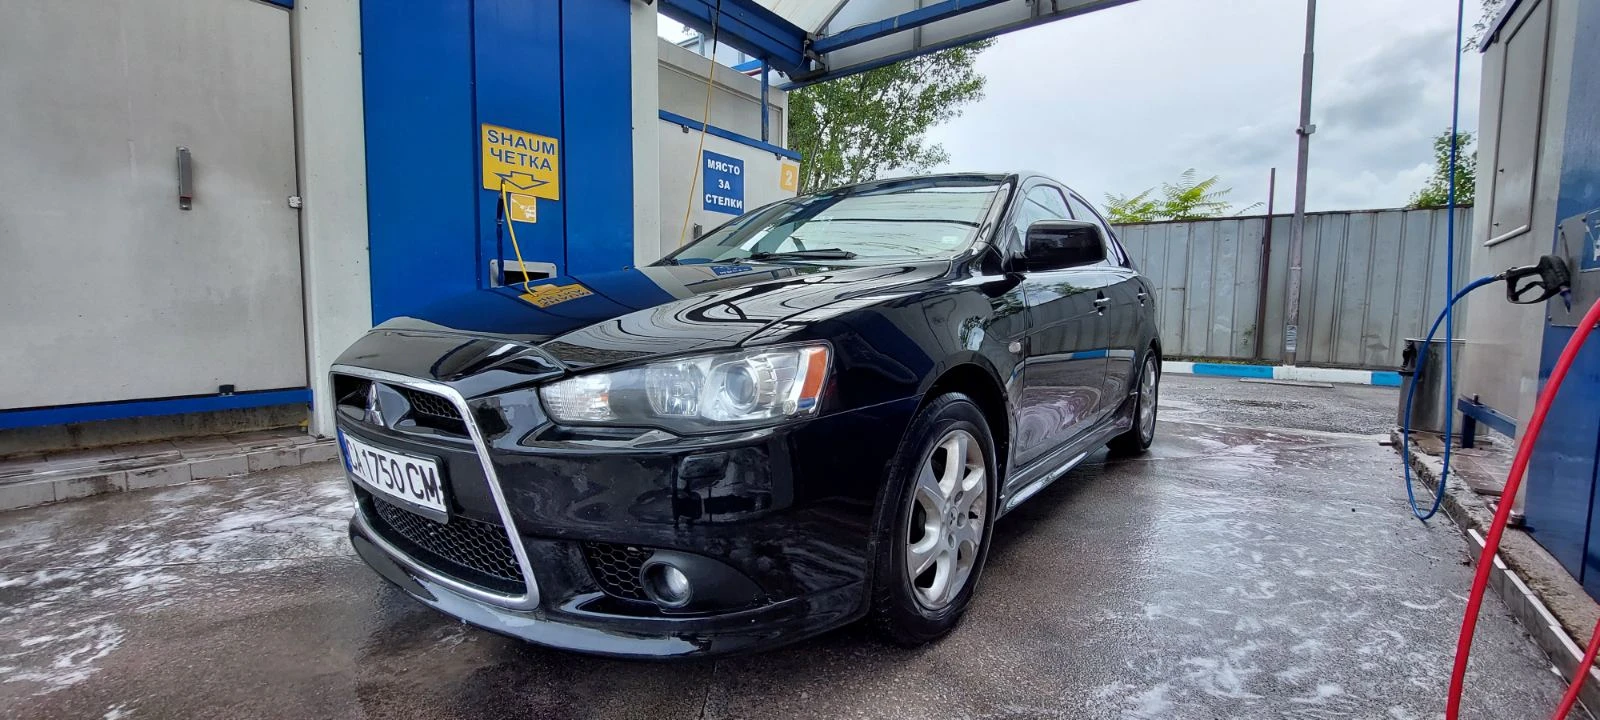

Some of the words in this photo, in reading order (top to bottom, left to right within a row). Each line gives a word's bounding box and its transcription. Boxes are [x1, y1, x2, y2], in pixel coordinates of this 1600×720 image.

[487, 129, 555, 155] SHAUM
[490, 147, 552, 171] ЧЕТКА
[707, 158, 740, 175] МЯСТО
[718, 179, 731, 190] ЗА
[785, 170, 793, 186] 2
[705, 194, 743, 209] СТЕЛКИ
